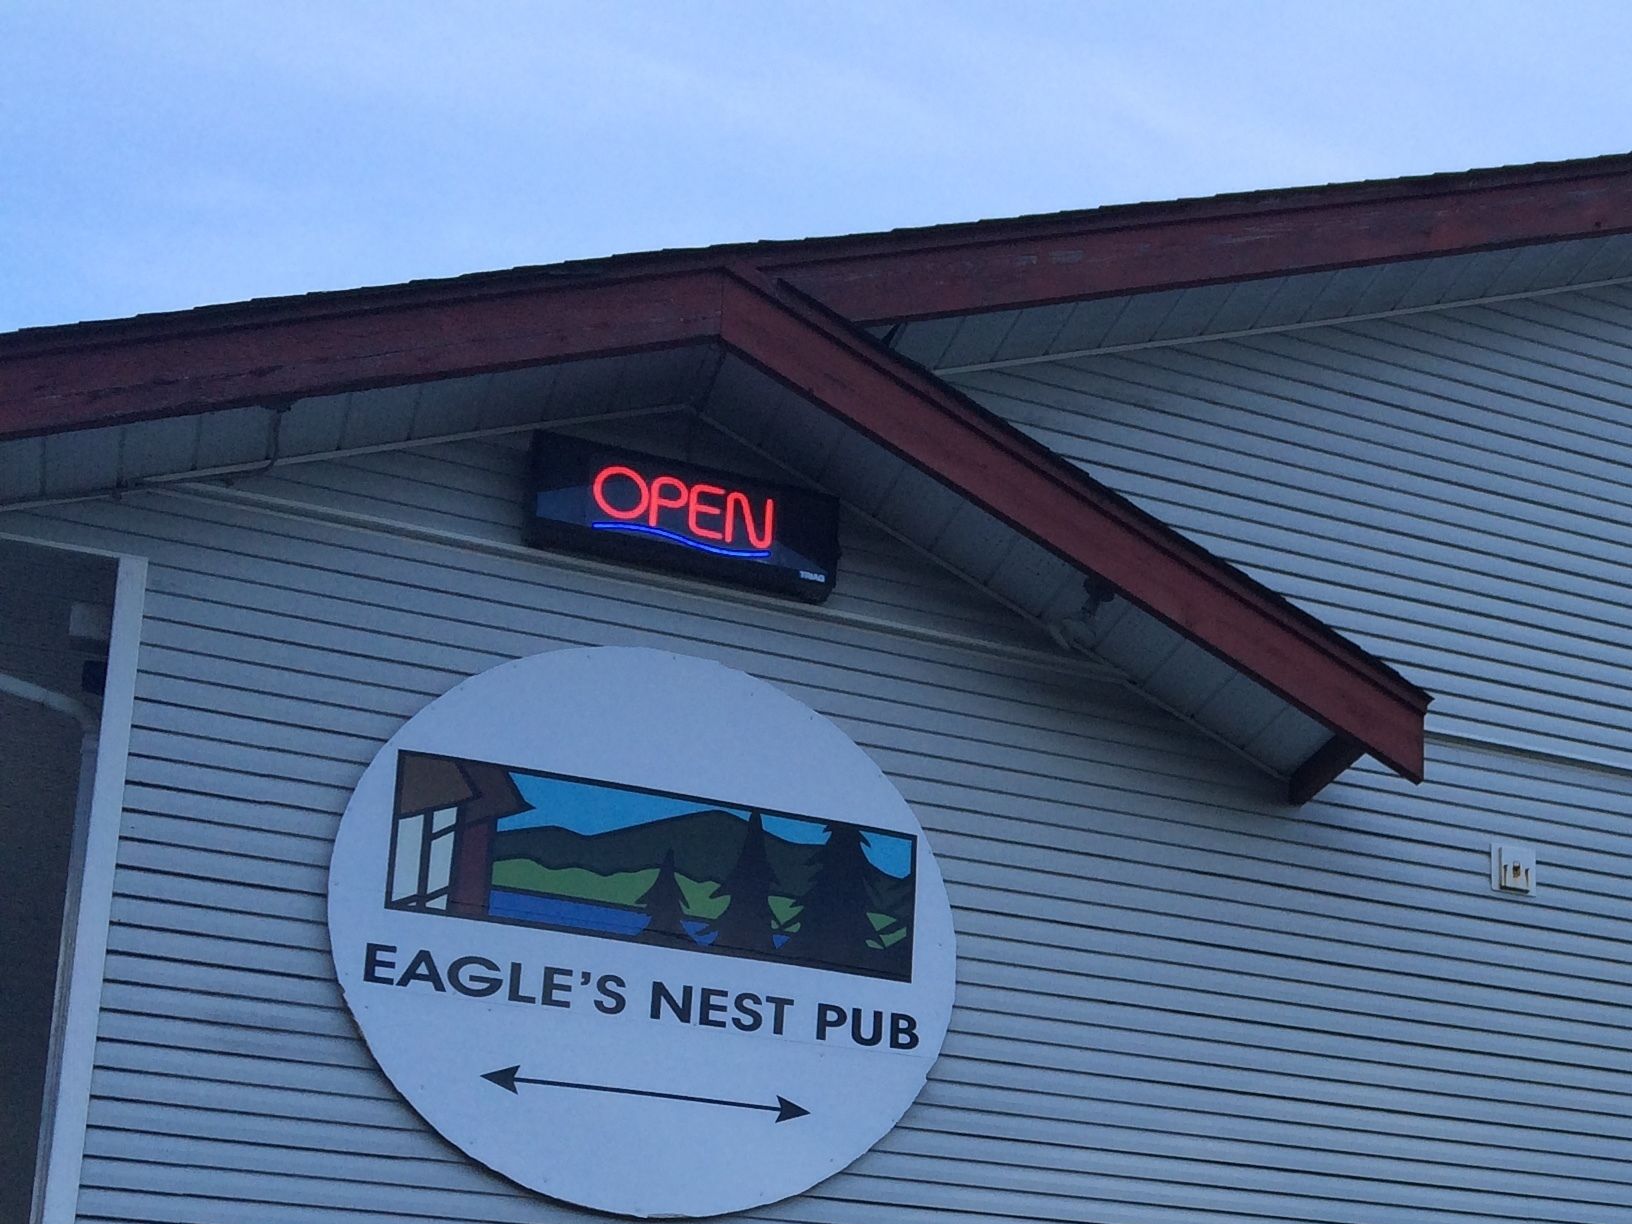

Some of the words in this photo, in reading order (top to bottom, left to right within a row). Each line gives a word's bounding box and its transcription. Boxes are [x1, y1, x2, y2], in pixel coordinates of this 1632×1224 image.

[593, 466, 774, 549] OPEN
[363, 942, 626, 1014] EAGLE'S
[650, 981, 794, 1035] NEST
[816, 1003, 920, 1050] PUB
